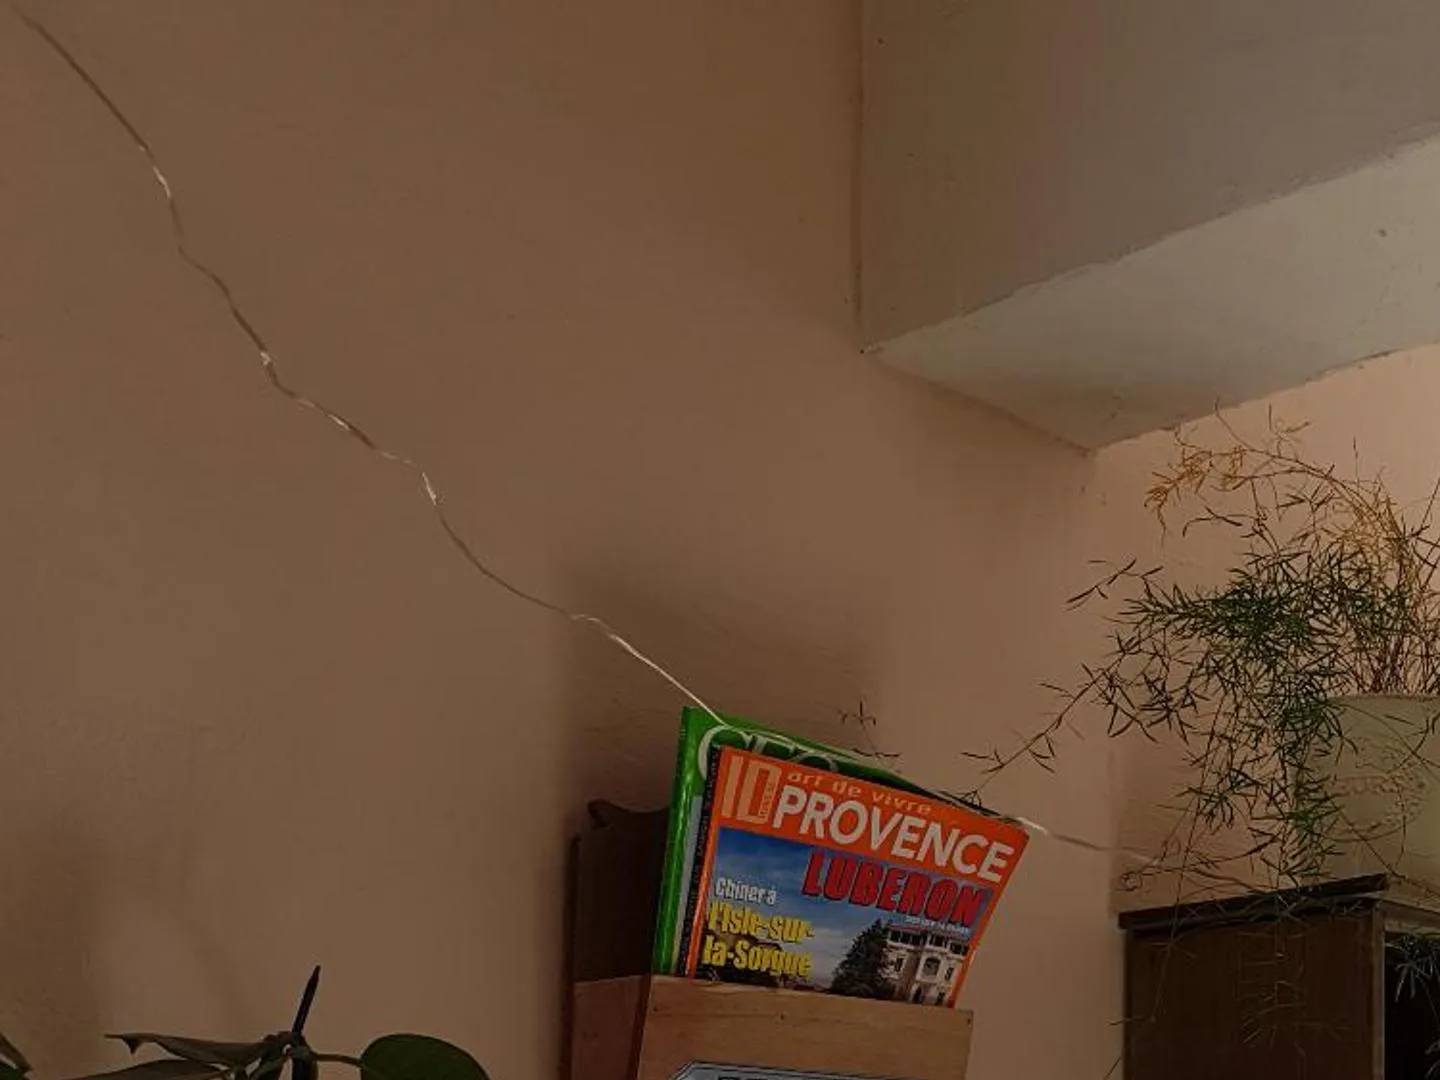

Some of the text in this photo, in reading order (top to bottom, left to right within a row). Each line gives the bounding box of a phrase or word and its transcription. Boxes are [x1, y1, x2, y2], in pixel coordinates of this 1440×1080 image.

[772, 784, 1015, 882] PROVENCE
[872, 790, 932, 814] vivre
[801, 850, 988, 928] LUBERON
